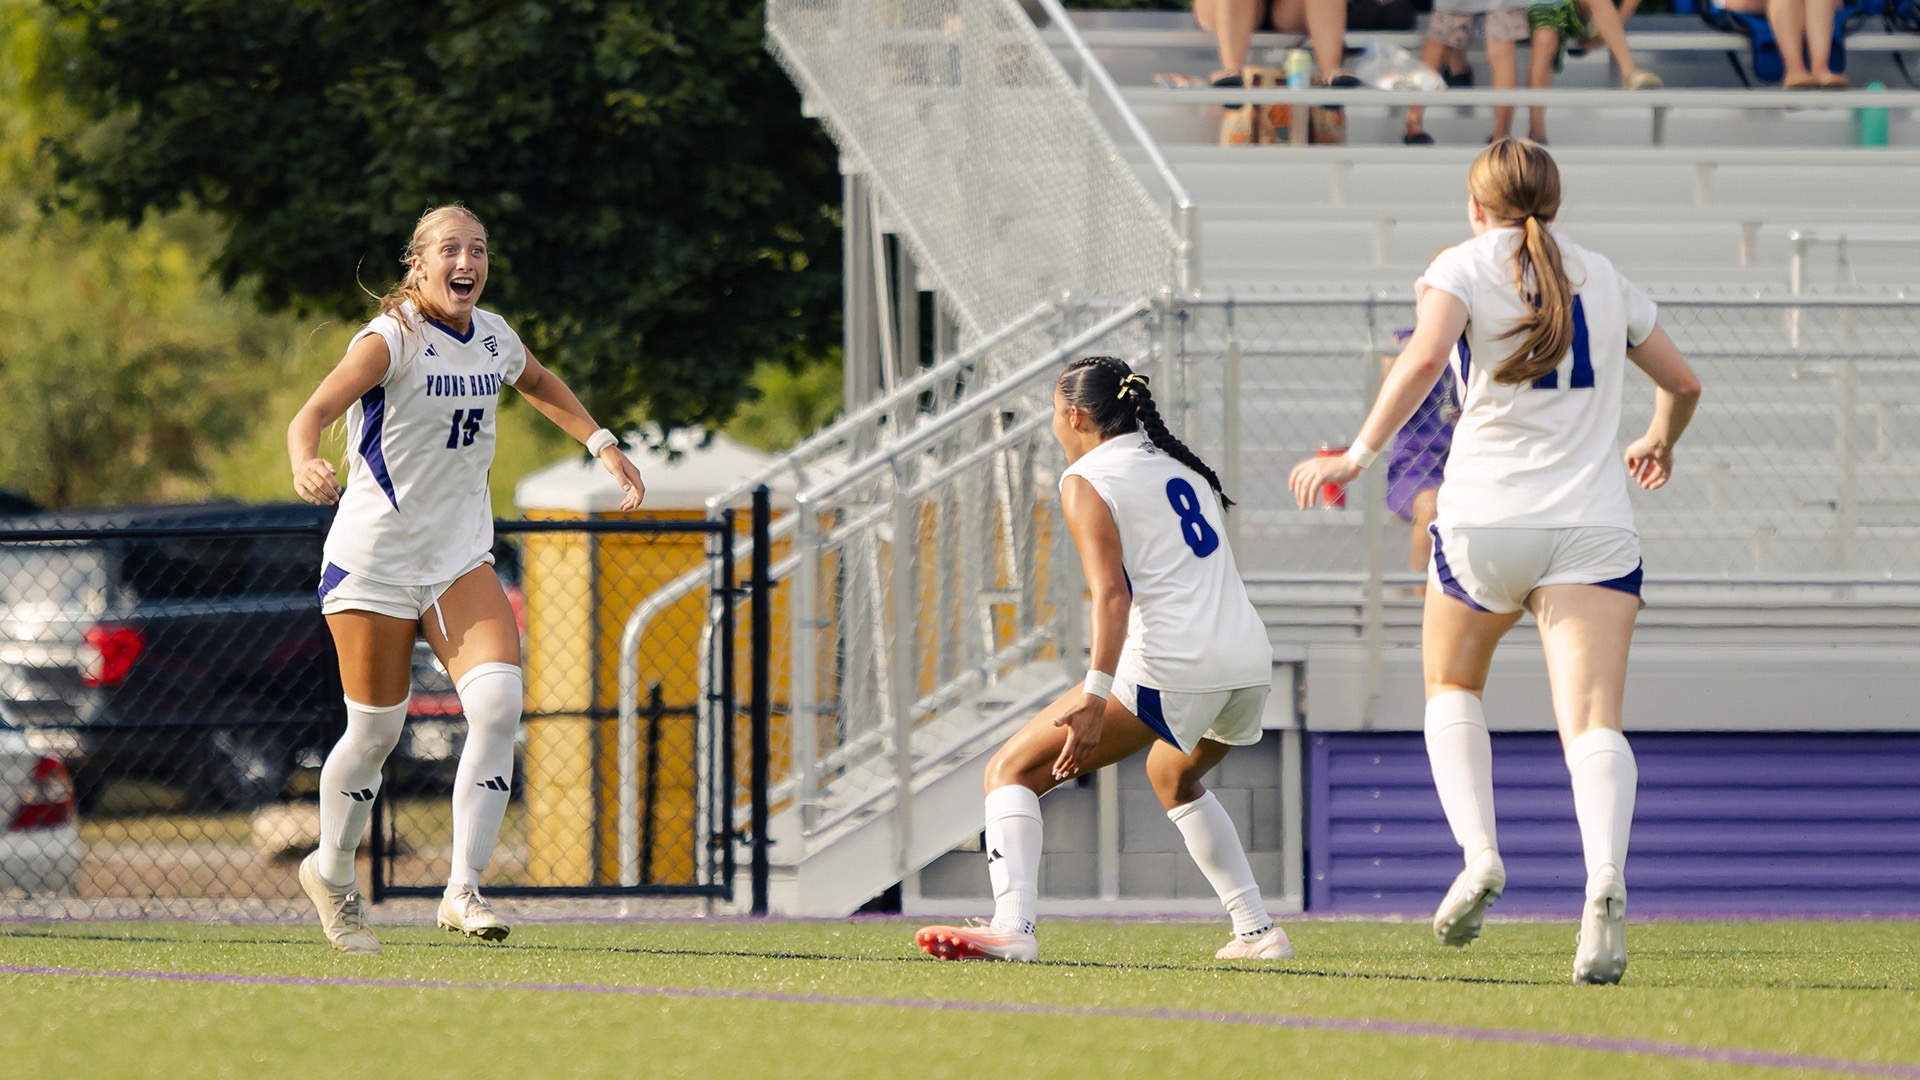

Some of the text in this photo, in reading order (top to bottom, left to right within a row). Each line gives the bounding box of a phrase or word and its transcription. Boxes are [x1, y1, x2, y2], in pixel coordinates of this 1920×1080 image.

[426, 375, 466, 397] YOUNG
[446, 409, 484, 449] 15
[1166, 477, 1219, 558] 8
